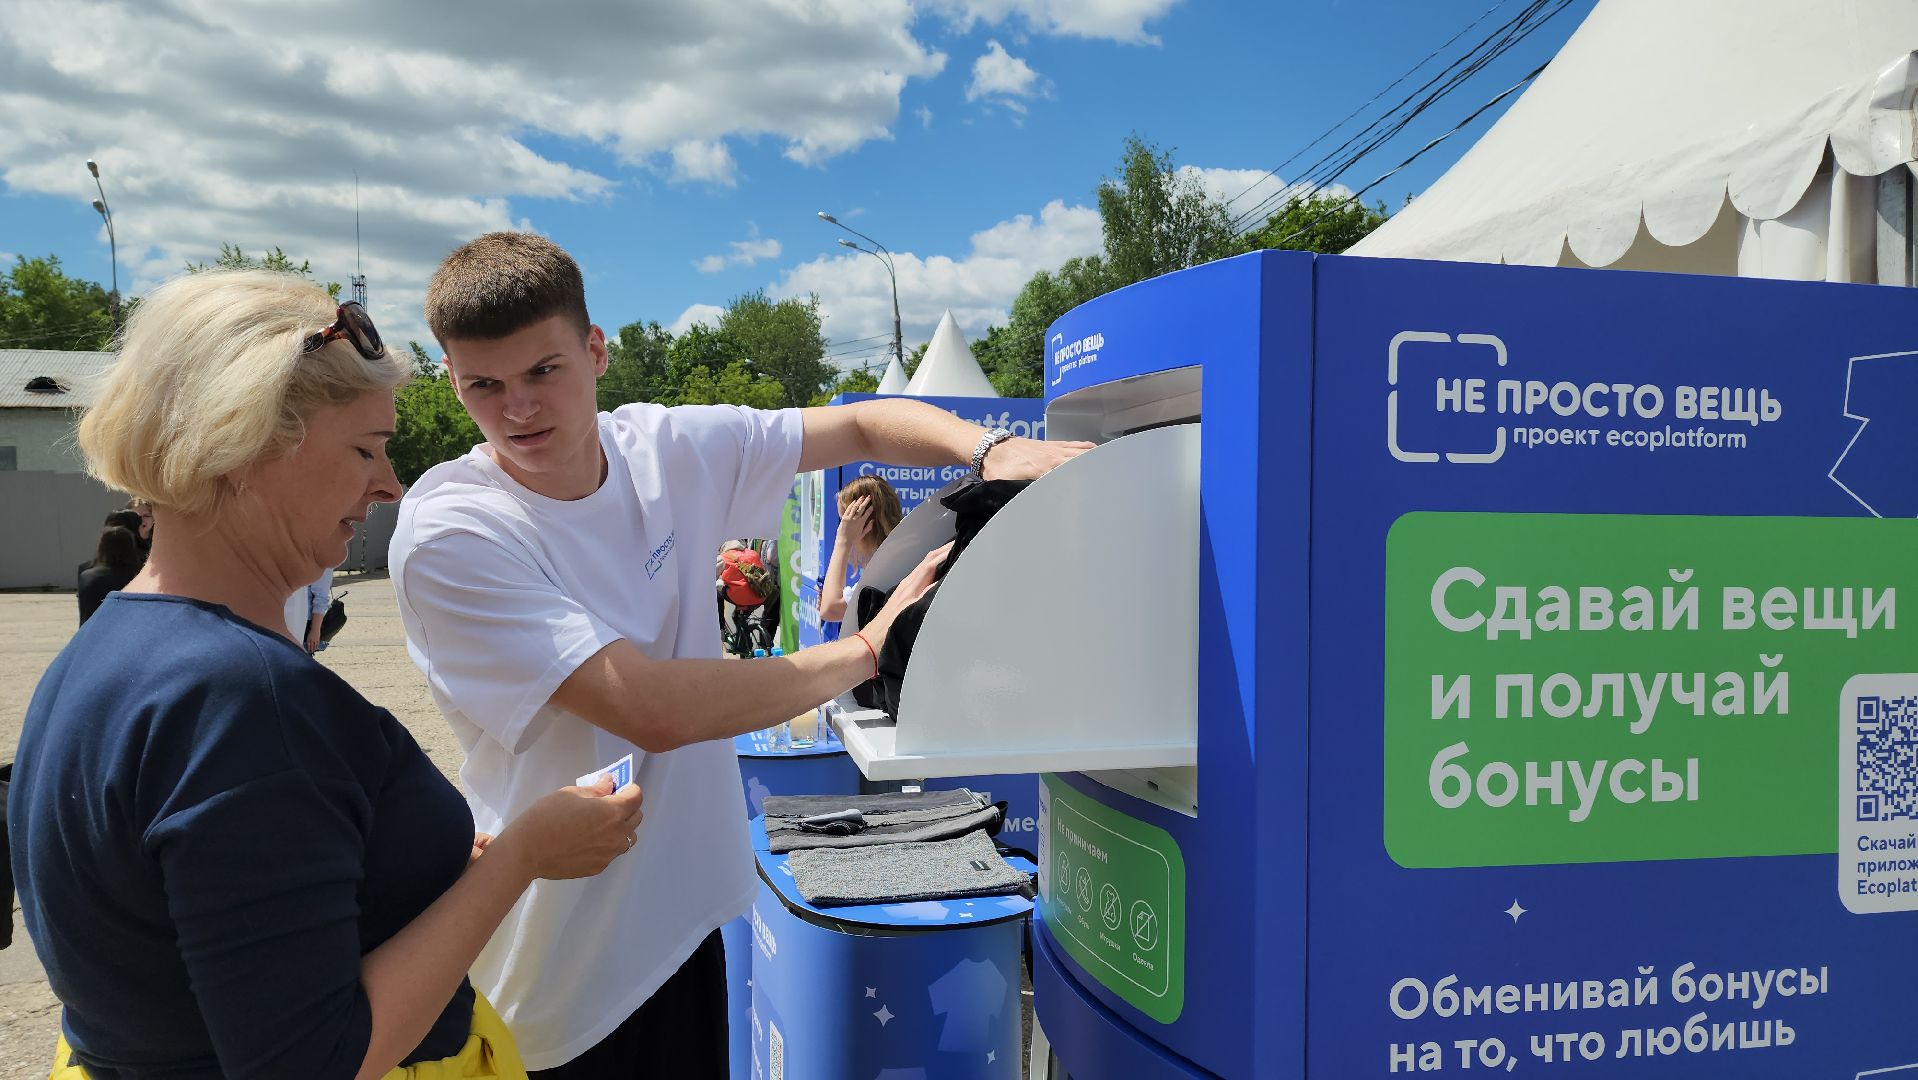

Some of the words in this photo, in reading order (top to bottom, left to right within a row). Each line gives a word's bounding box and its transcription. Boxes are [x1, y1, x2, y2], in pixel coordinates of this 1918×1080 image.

[1083, 333, 1105, 352] ВЕЩЬ
[1436, 377, 1486, 412] НЕ
[1497, 380, 1665, 418] ПРОСТО
[1675, 386, 1783, 427] ВЕЩЬ
[1513, 426, 1600, 448] проект
[1606, 425, 1747, 452] ecoplatform
[1430, 566, 1699, 641] Сдавай
[1722, 586, 1897, 638] вещи
[1431, 674, 1471, 720] и
[1495, 653, 1790, 735] получай
[1428, 741, 1700, 823] бонусы
[1857, 833, 1917, 853] Скачай
[1389, 966, 1658, 1020] Обменивай
[1671, 961, 1829, 1009] бонусы
[1390, 1041, 1442, 1073] на
[1453, 1036, 1518, 1073] то,
[1530, 1030, 1606, 1064] что
[1615, 1011, 1796, 1059] любишь
